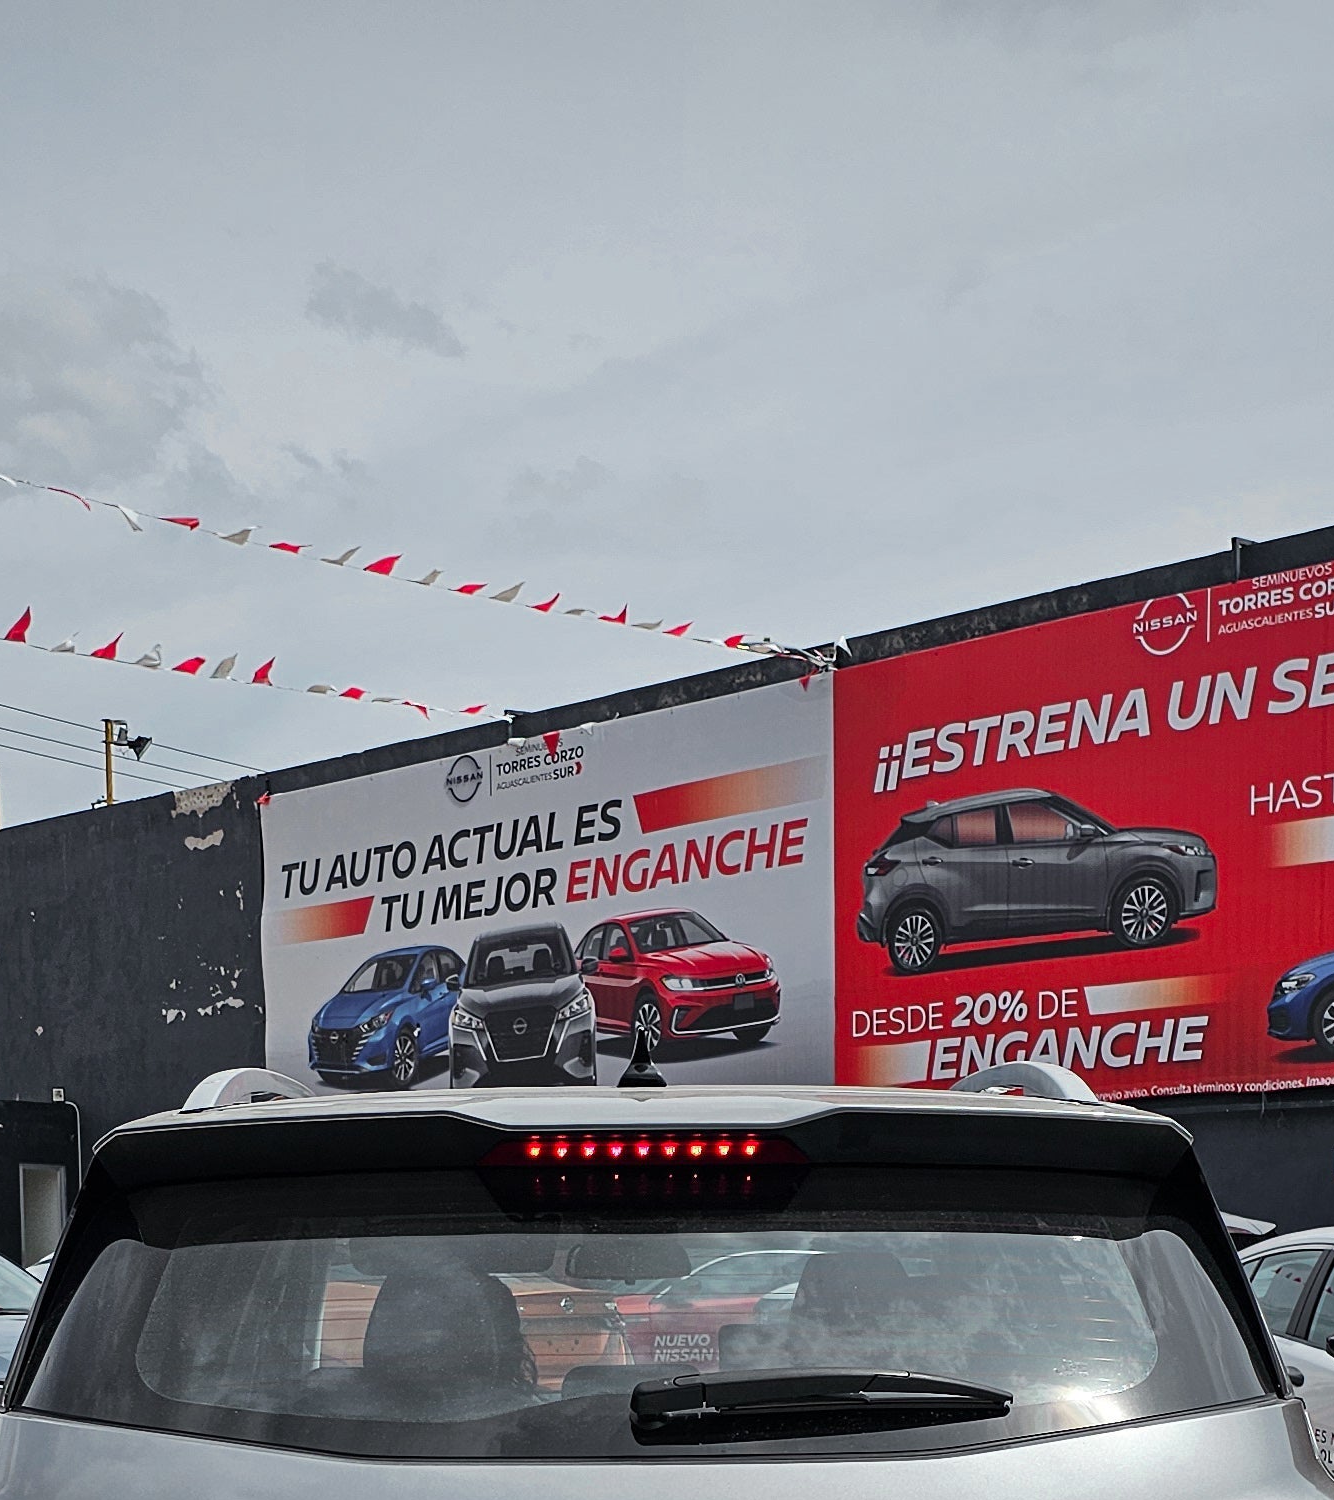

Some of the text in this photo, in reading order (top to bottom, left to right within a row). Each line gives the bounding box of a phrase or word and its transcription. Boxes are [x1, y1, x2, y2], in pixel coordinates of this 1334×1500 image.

[1252, 562, 1333, 590] SEMINUEVOS
[1218, 587, 1295, 617] TORRES
[1133, 610, 1198, 634] NISSAN
[1218, 608, 1313, 636] AGUASCALIENTES
[873, 684, 1149, 795] ¡¡ESTRENA
[1166, 667, 1257, 732] UN
[496, 745, 584, 776] TORRES CORZO
[553, 765, 575, 781] SUR
[446, 771, 484, 786] NISSAN
[281, 799, 623, 899] TU AUTO ACTUAL ES
[380, 817, 810, 932] TU MEJOR ENGANCHE
[852, 988, 1079, 1038] DESDE 20% DE
[931, 1015, 1209, 1081] ENGANCHE
[1123, 1087, 1150, 1100] aviso.
[1150, 1083, 1192, 1098] Consulta
[1193, 1081, 1236, 1095] términos
[1237, 1081, 1244, 1093] y
[1244, 1077, 1305, 1093] condiciones.
[653, 1333, 711, 1348] NUEVO
[653, 1348, 714, 1362] NISSAN
